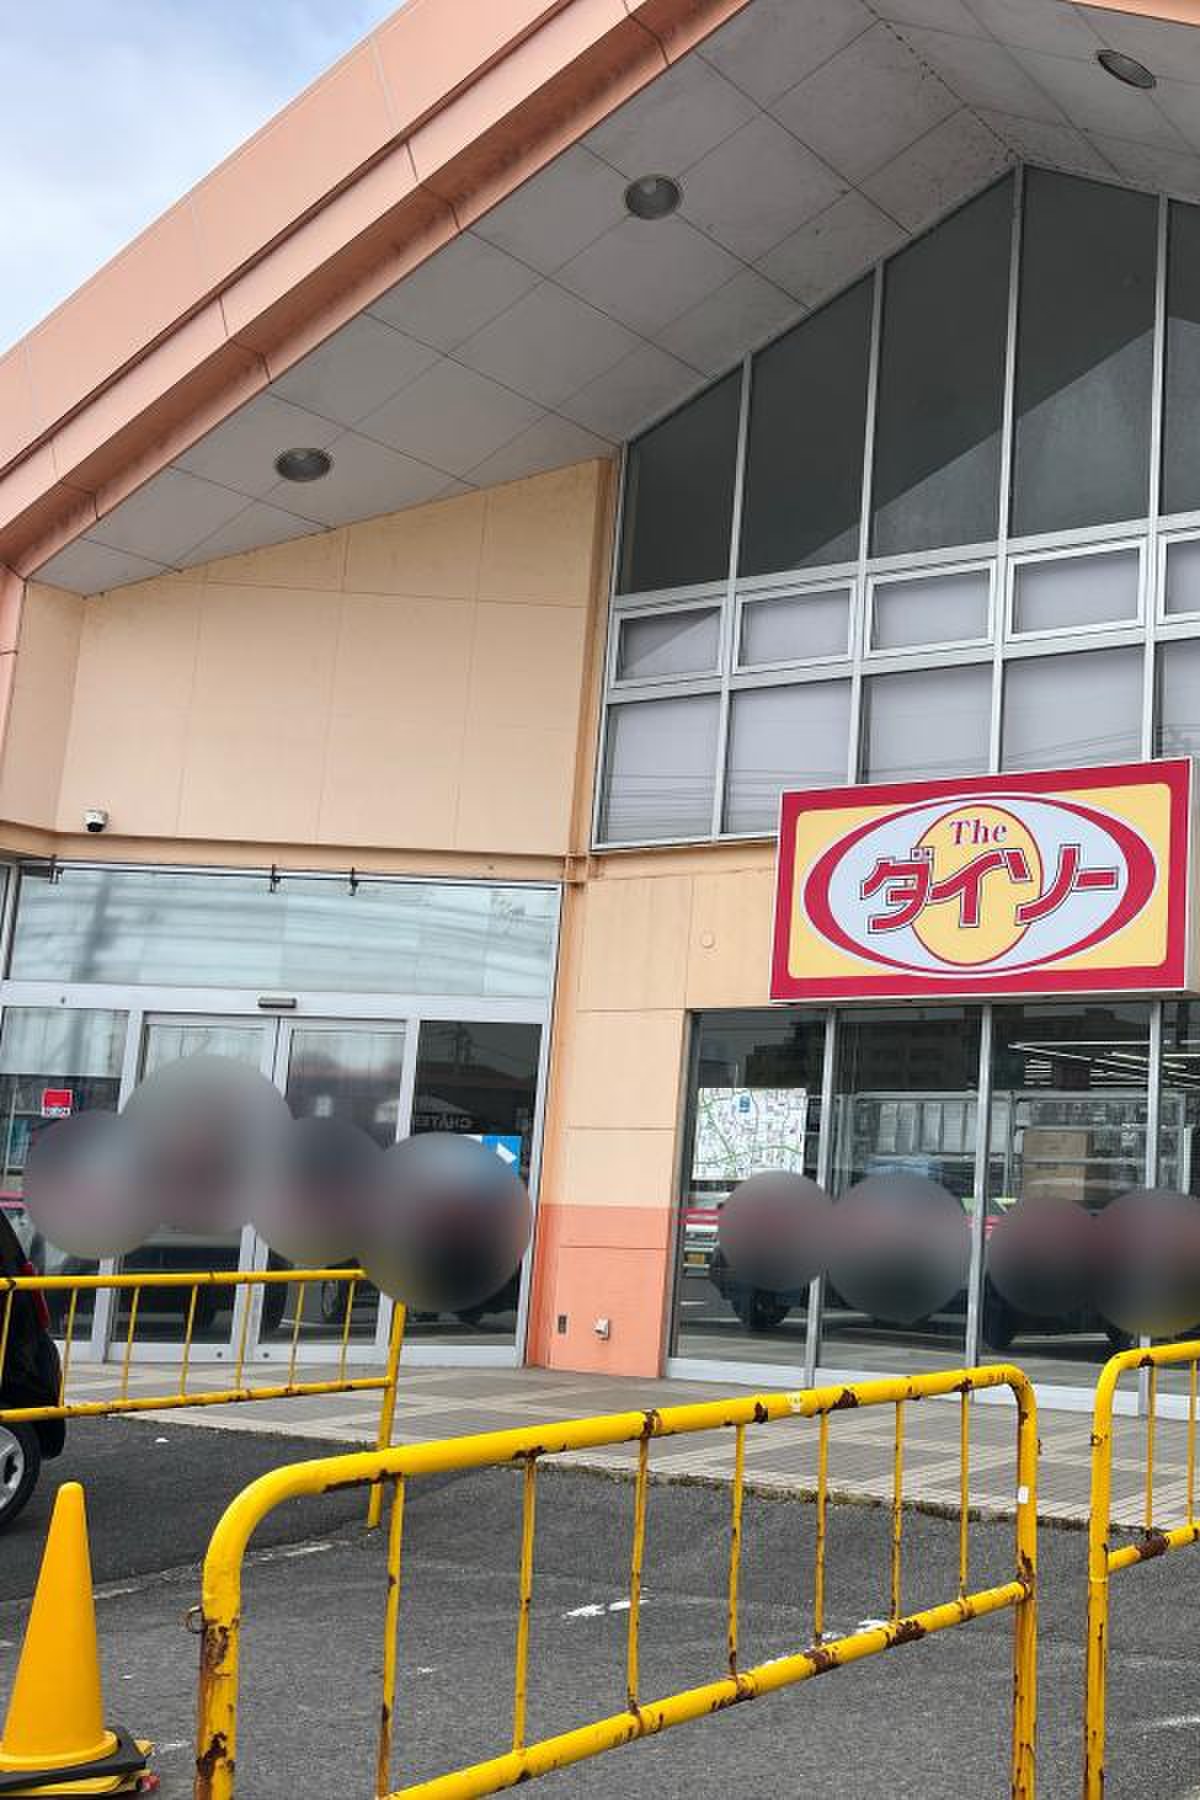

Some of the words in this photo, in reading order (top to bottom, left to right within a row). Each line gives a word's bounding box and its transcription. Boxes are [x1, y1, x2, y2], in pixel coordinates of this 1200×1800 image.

[949, 818, 1007, 845] The
[859, 844, 1119, 934] ダイソー
